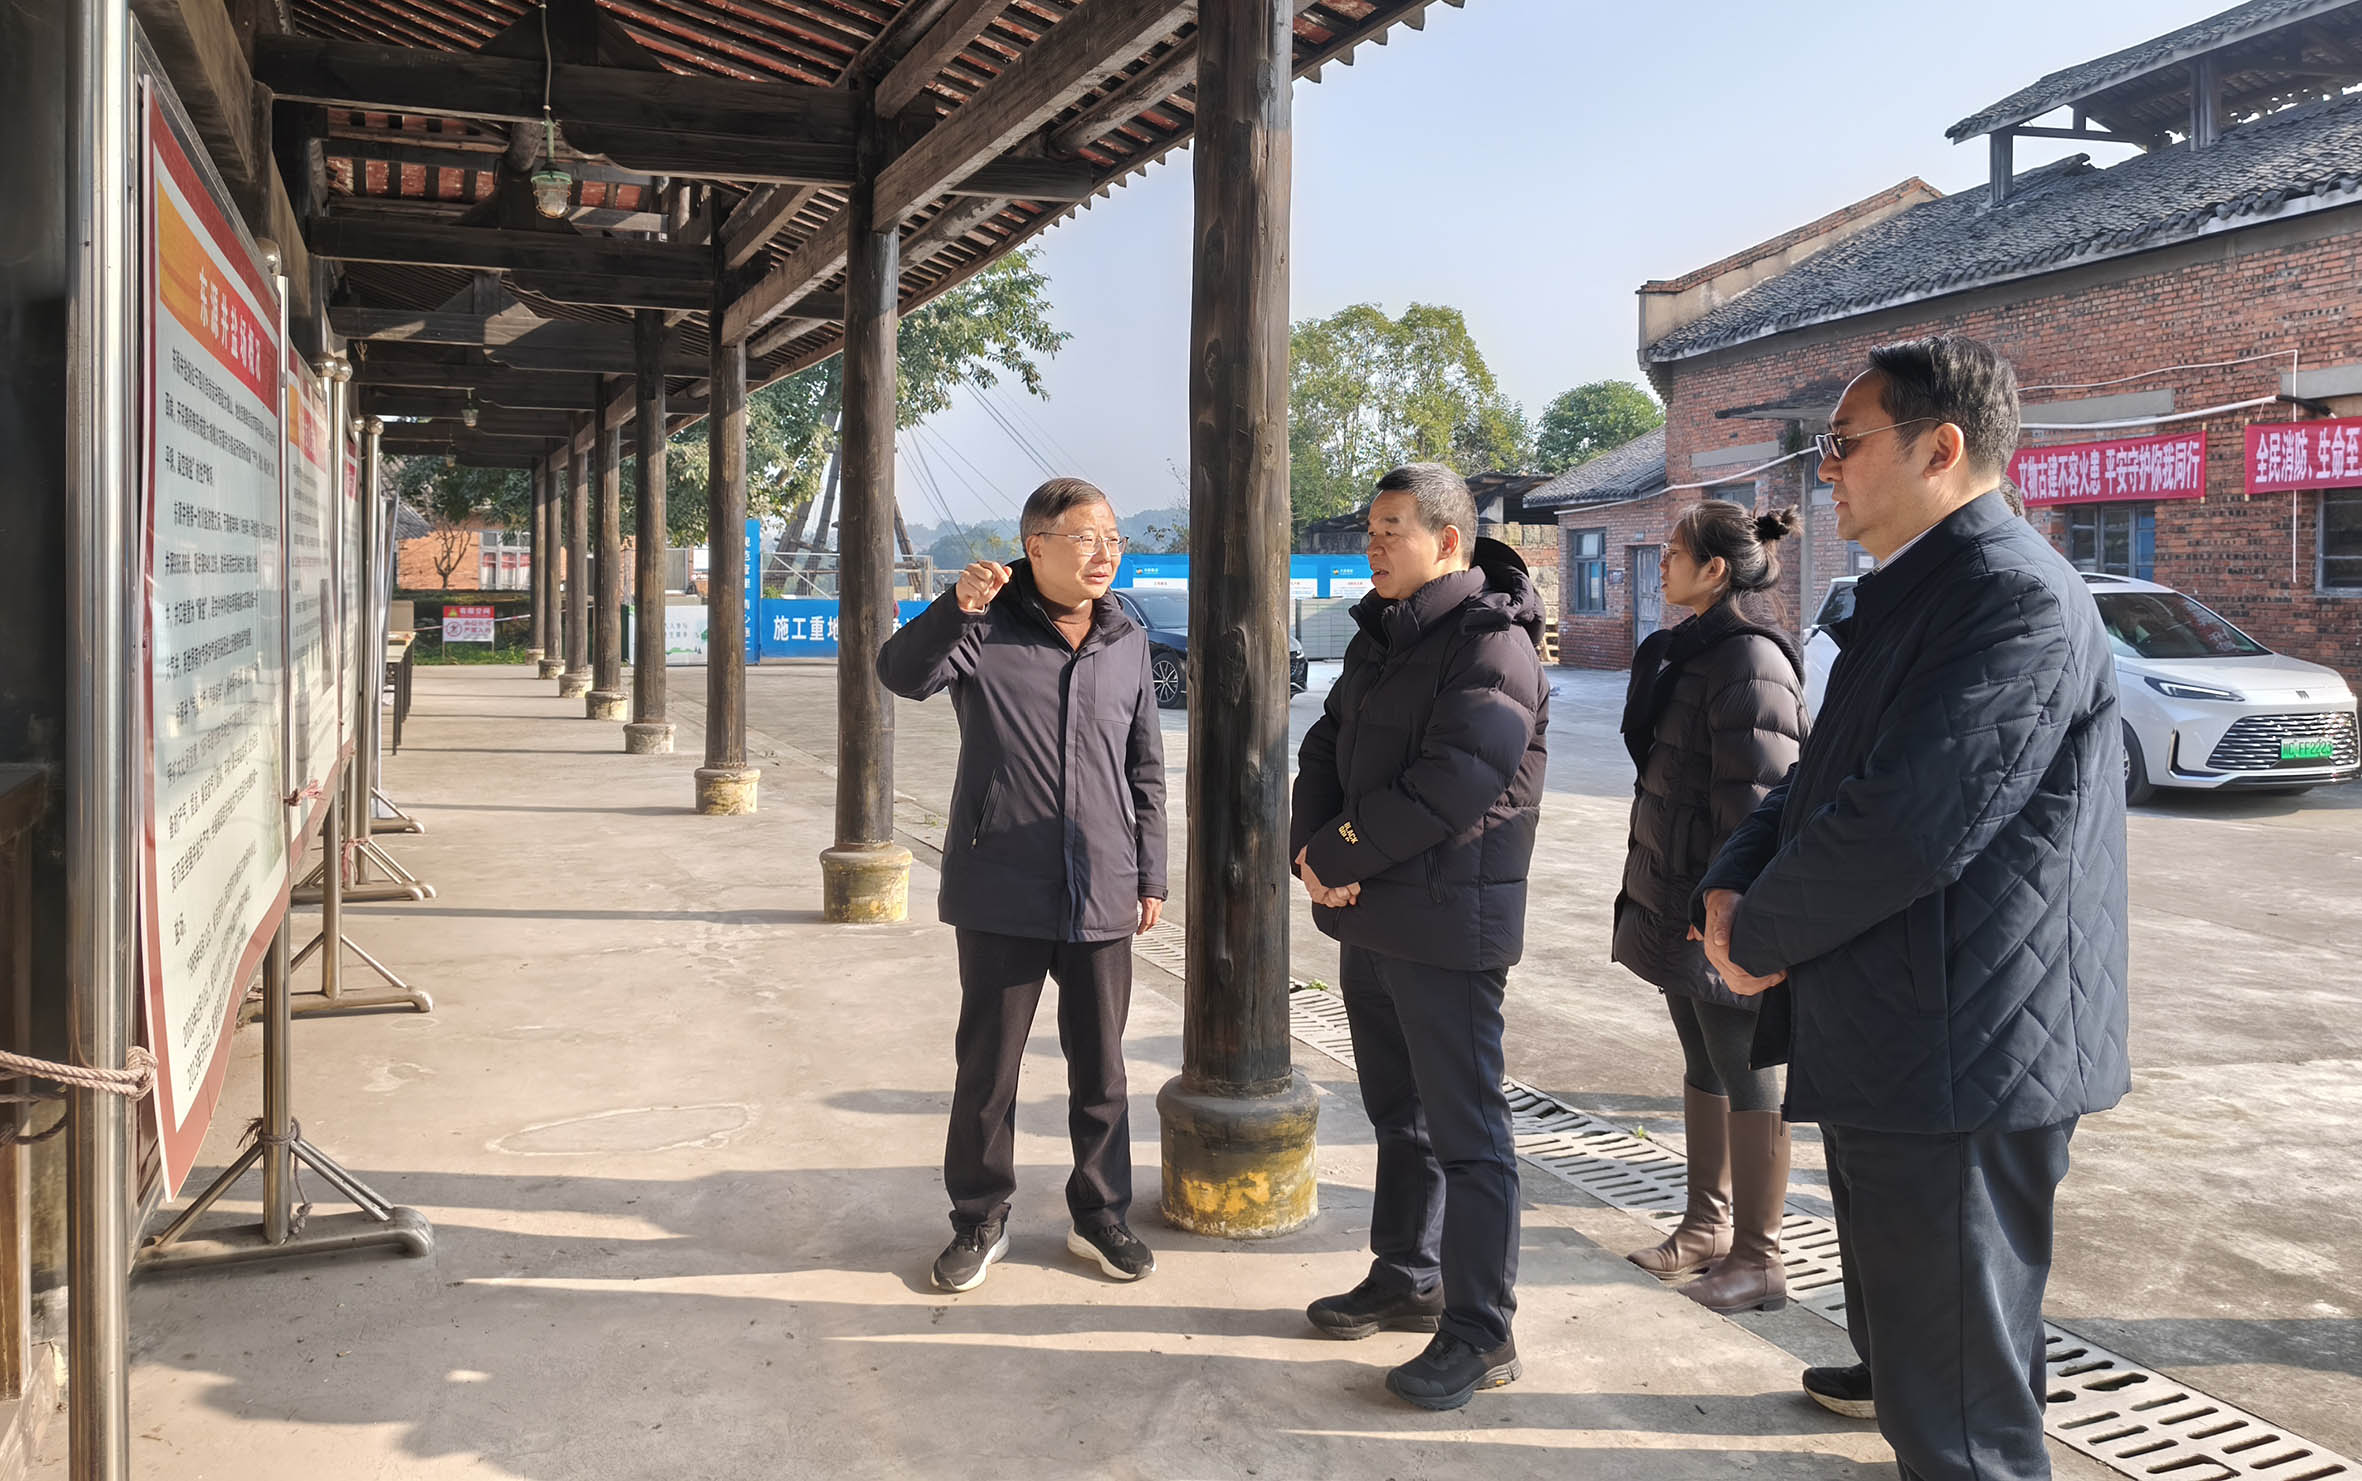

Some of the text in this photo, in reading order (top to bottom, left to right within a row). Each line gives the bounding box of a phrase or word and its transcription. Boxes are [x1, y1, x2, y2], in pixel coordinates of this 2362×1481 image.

[2017, 439, 2200, 500] 文物古建不容火患 平安守护你我同行
[2254, 424, 2362, 483] 全民消防、生命至
[773, 614, 839, 641] 施工重地
